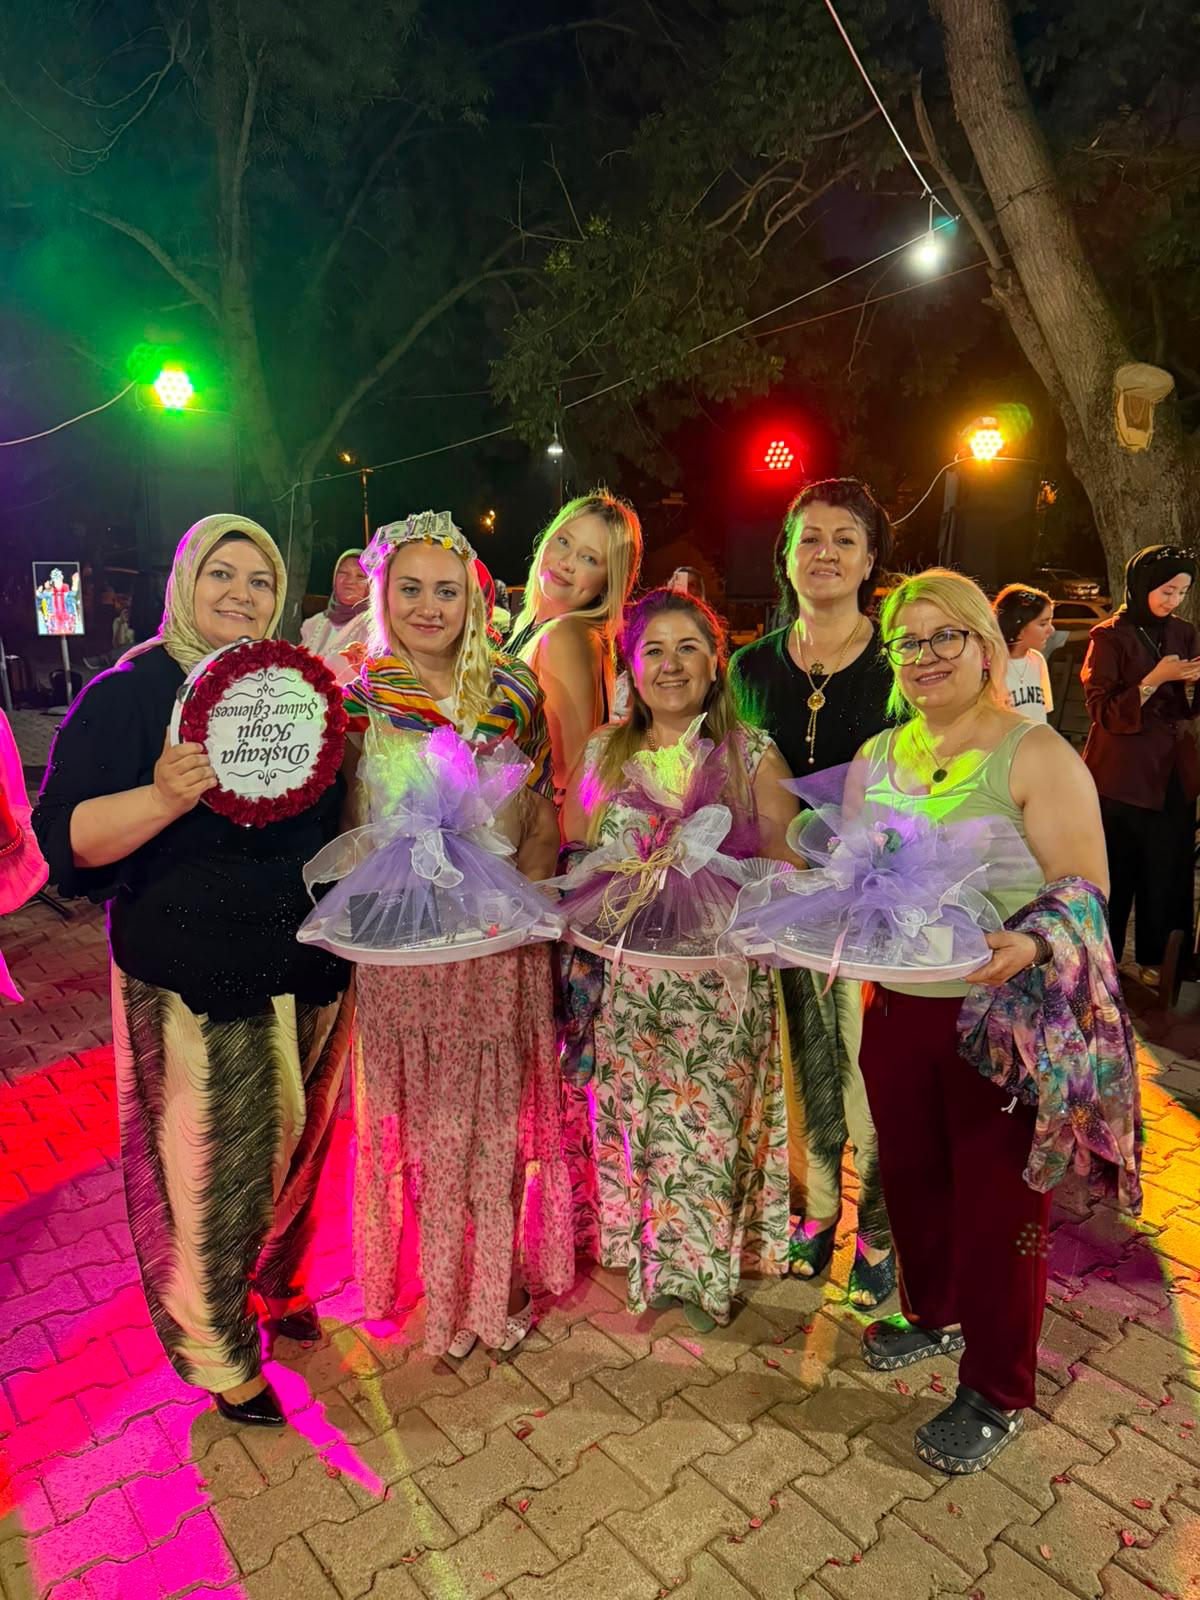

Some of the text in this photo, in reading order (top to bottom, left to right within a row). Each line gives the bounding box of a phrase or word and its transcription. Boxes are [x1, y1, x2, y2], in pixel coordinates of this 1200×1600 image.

[209, 698, 318, 722] Şalvar Eğlencesi
[237, 719, 295, 743] Köyü
[220, 742, 310, 767] Dışkaya
